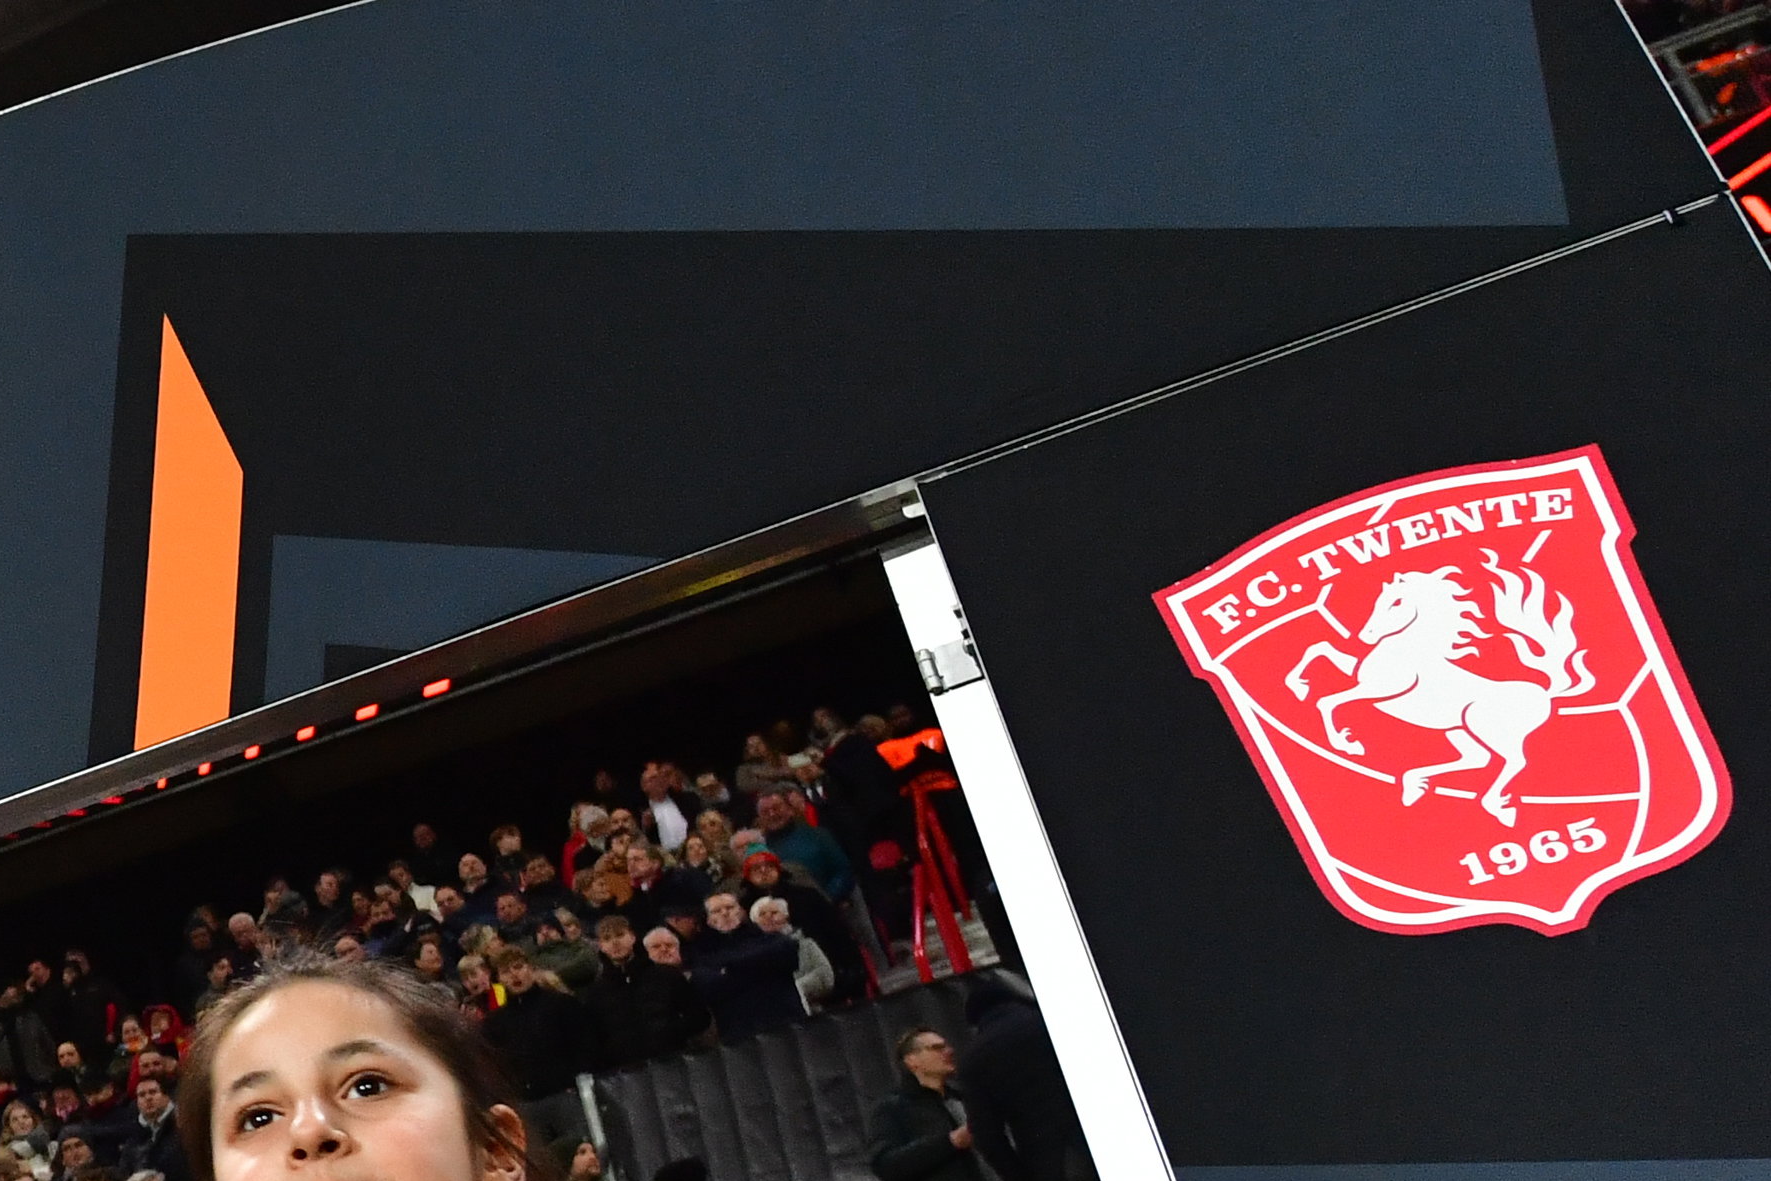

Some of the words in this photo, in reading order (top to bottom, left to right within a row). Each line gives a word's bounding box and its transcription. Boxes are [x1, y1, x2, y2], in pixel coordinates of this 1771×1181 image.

[1201, 571, 1303, 634] F.C.
[1297, 487, 1575, 582] TWENTE
[1457, 817, 1608, 886] 1965
